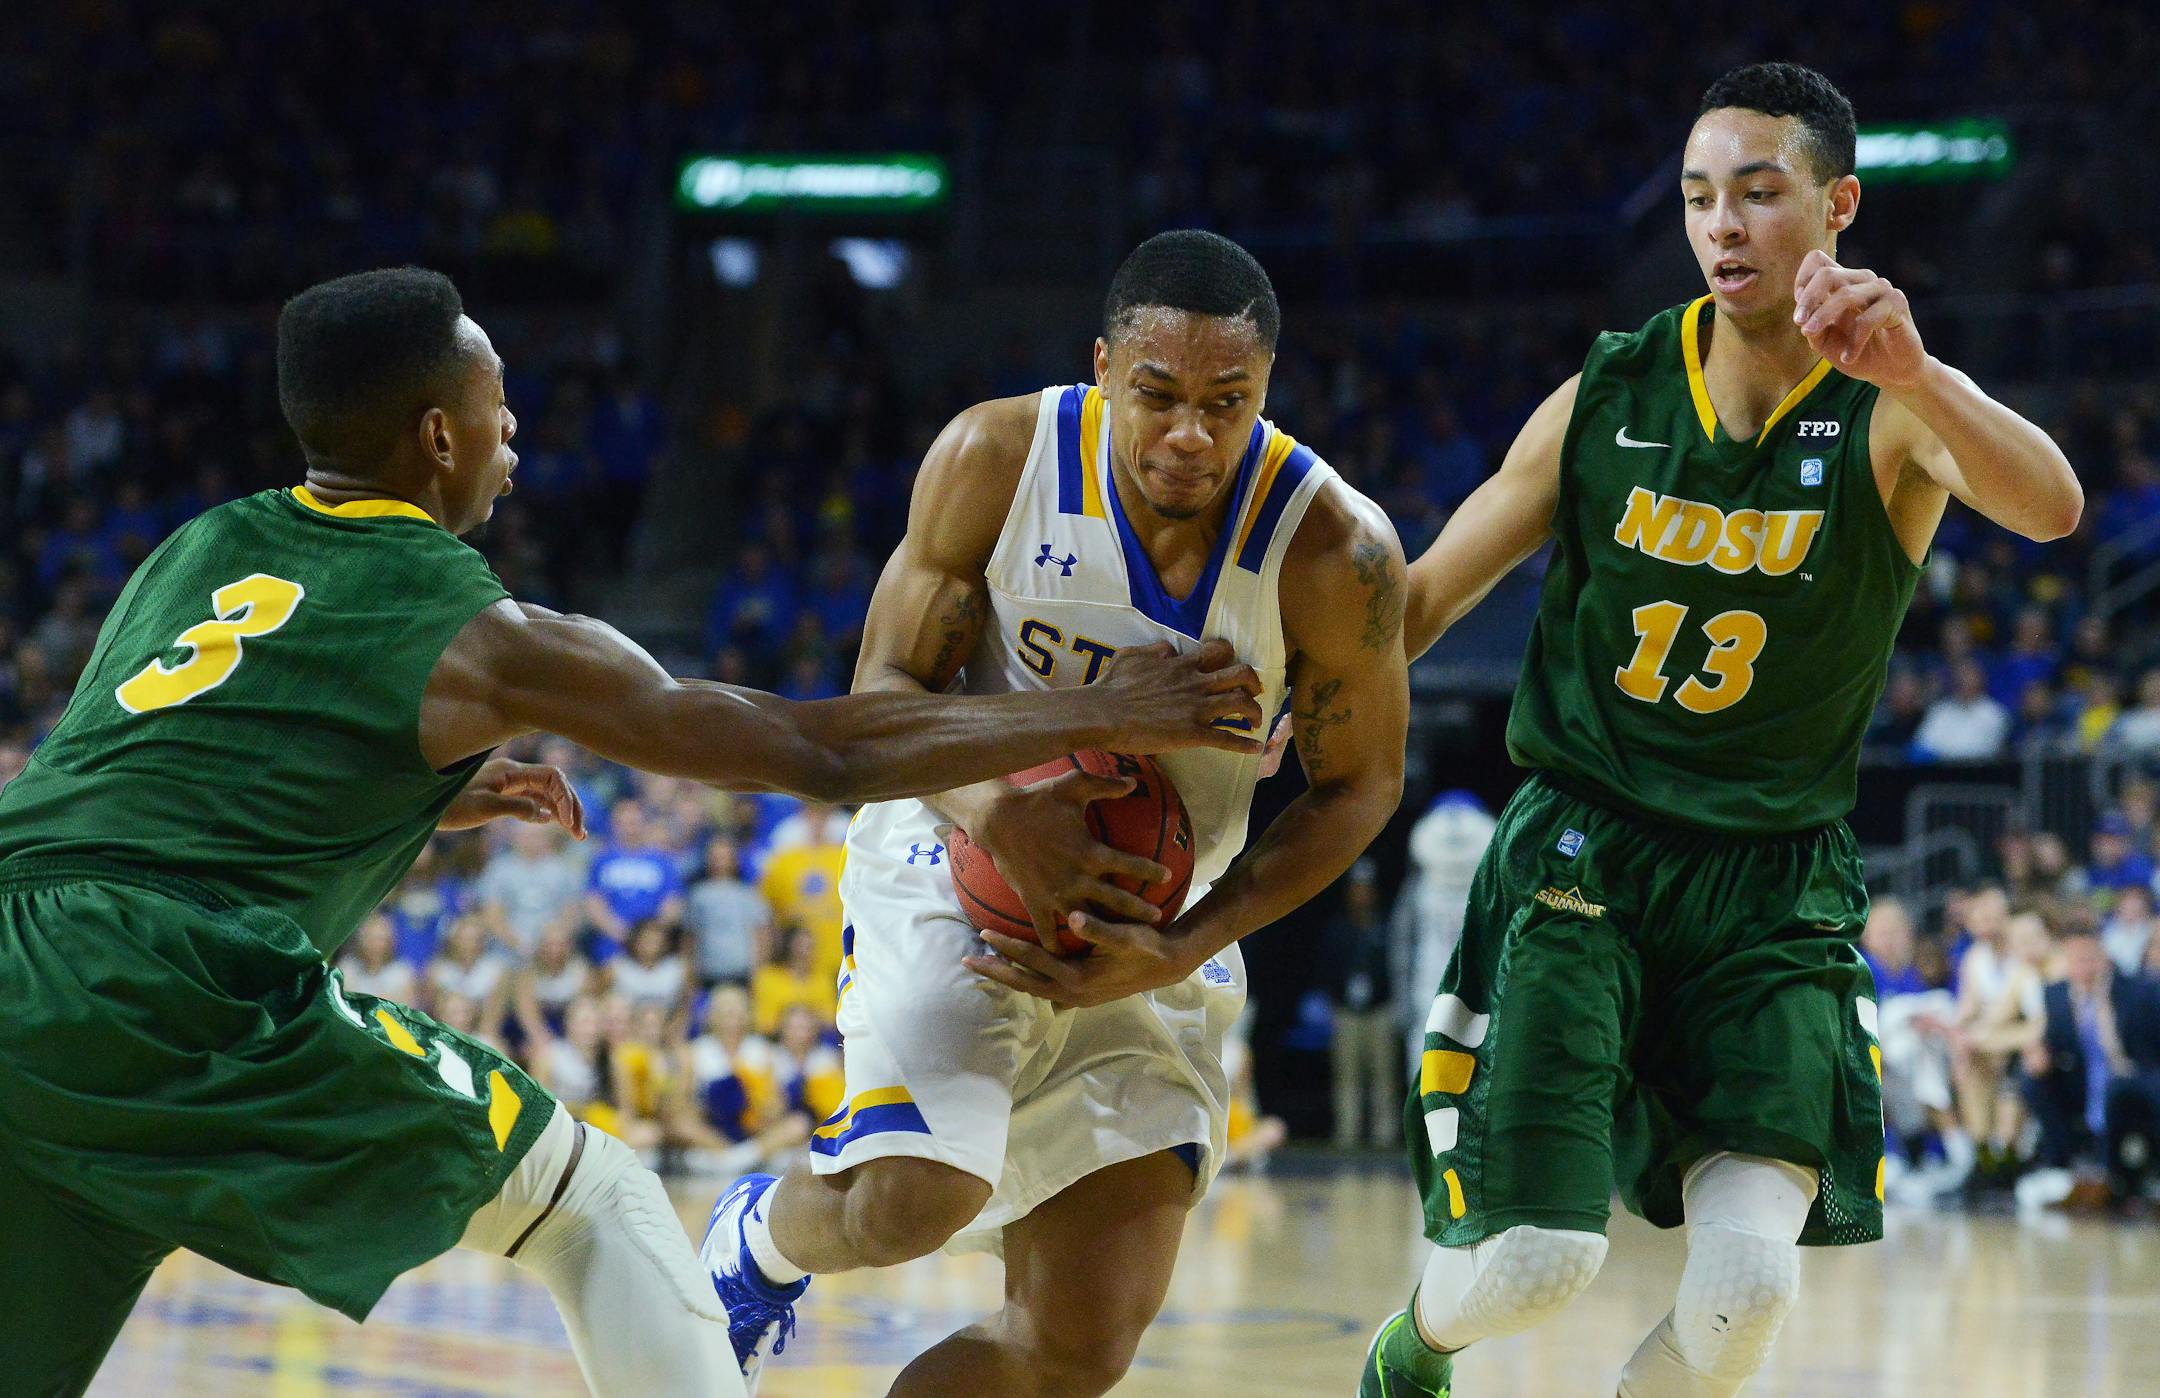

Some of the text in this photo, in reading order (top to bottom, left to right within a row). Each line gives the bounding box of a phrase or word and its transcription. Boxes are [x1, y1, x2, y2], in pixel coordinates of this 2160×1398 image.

[1797, 421, 1840, 437] FPD
[1614, 485, 1825, 577] NDSU
[1799, 572, 1812, 582] TM
[114, 572, 305, 715] 3
[1614, 599, 1768, 714] 13
[1535, 889, 1606, 918] SUMMIT
